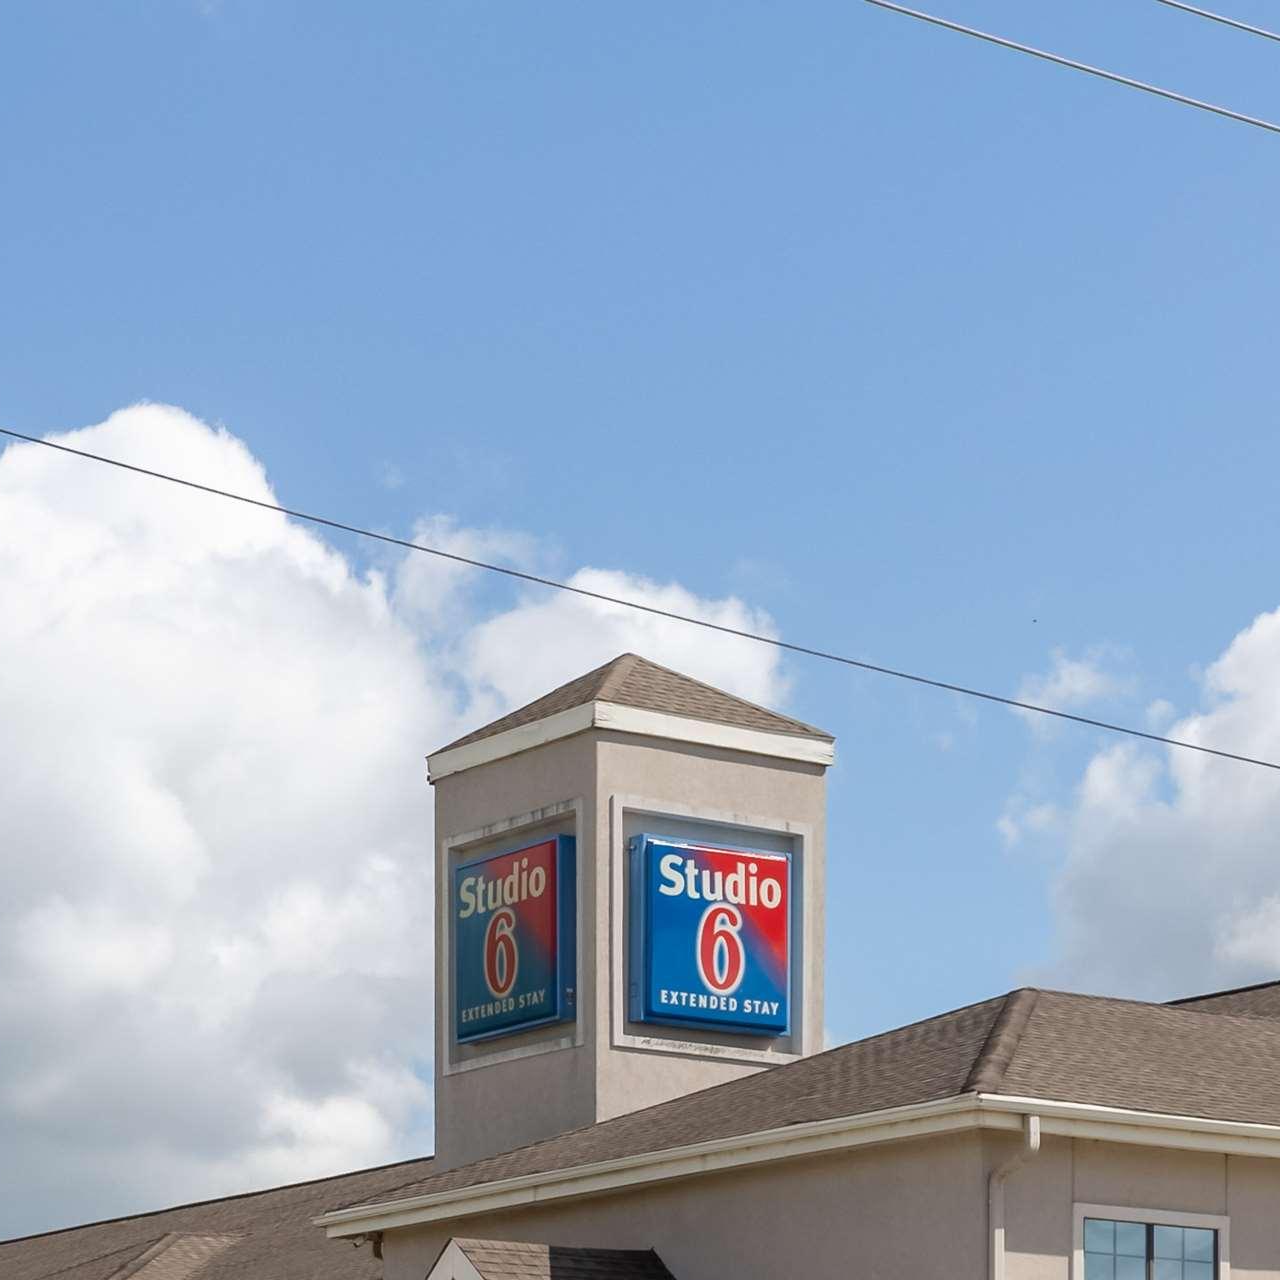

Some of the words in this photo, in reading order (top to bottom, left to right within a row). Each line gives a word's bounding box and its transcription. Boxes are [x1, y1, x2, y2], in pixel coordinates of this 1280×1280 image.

[458, 857, 547, 919] Studio
[658, 854, 783, 909] Studio
[484, 909, 517, 996] 6
[698, 904, 743, 992] 6
[461, 997, 516, 1024] EXTENDED
[518, 988, 547, 1010] STAY
[660, 989, 738, 1013] EXTENDED
[743, 999, 780, 1016] STAY
